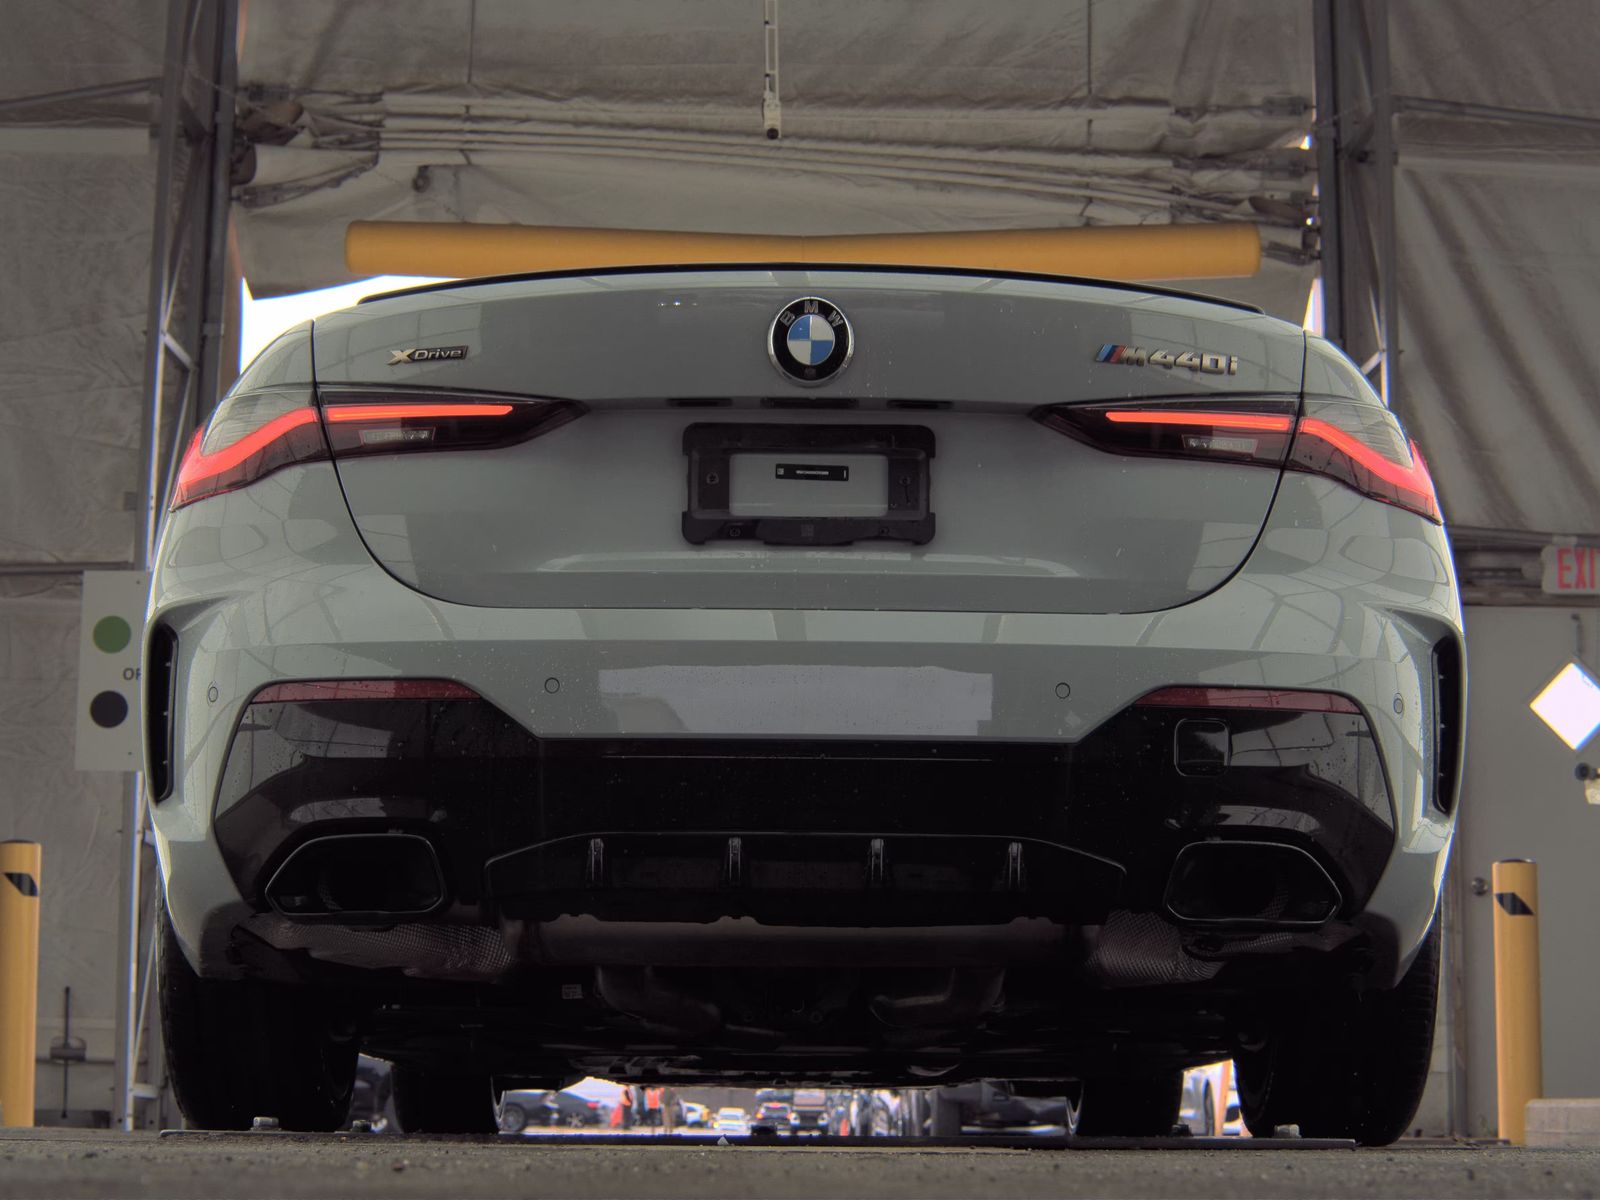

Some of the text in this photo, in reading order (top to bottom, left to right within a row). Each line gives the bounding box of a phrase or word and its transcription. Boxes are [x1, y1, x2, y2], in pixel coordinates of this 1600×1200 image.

[780, 300, 844, 328] BMW
[1118, 345, 1238, 375] M440i
[1557, 547, 1600, 590] EXI
